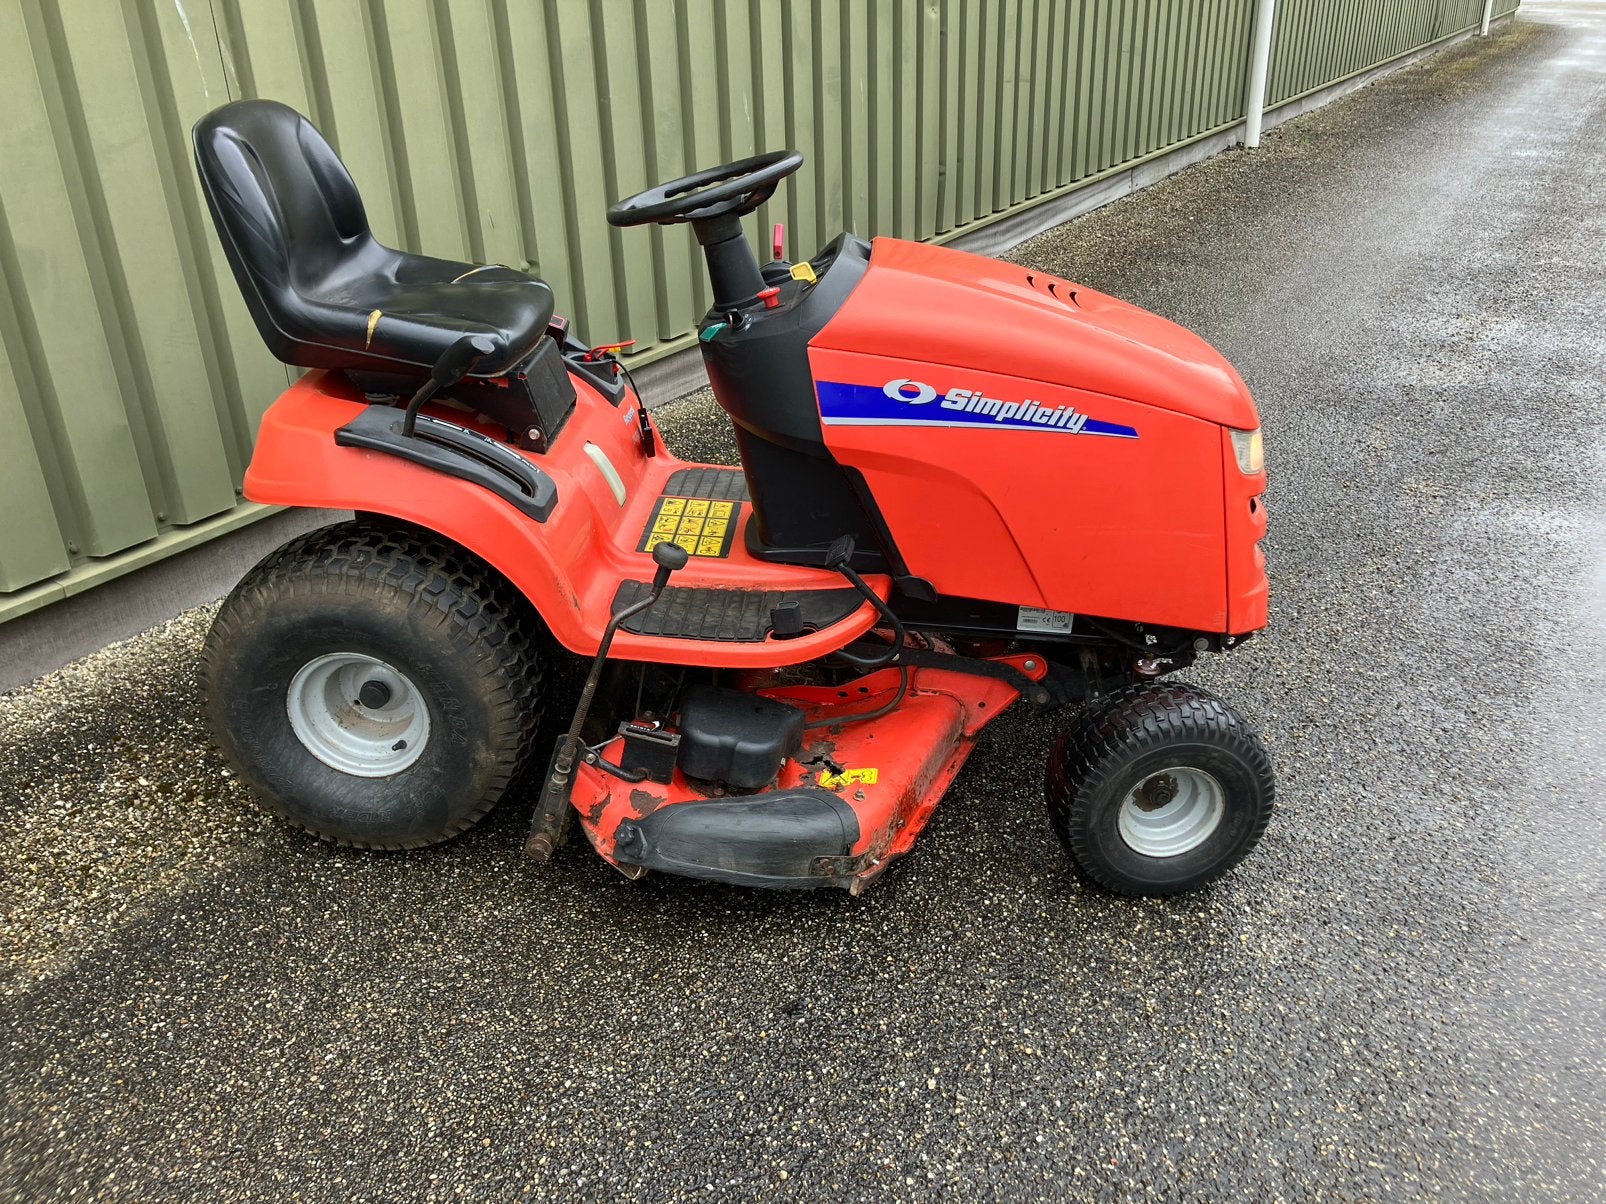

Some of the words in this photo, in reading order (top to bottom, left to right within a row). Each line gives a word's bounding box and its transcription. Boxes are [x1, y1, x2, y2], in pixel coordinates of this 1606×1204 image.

[940, 388, 1089, 435] Simplicity
[1054, 615, 1065, 623] 100
[416, 662, 468, 746] KENDA
